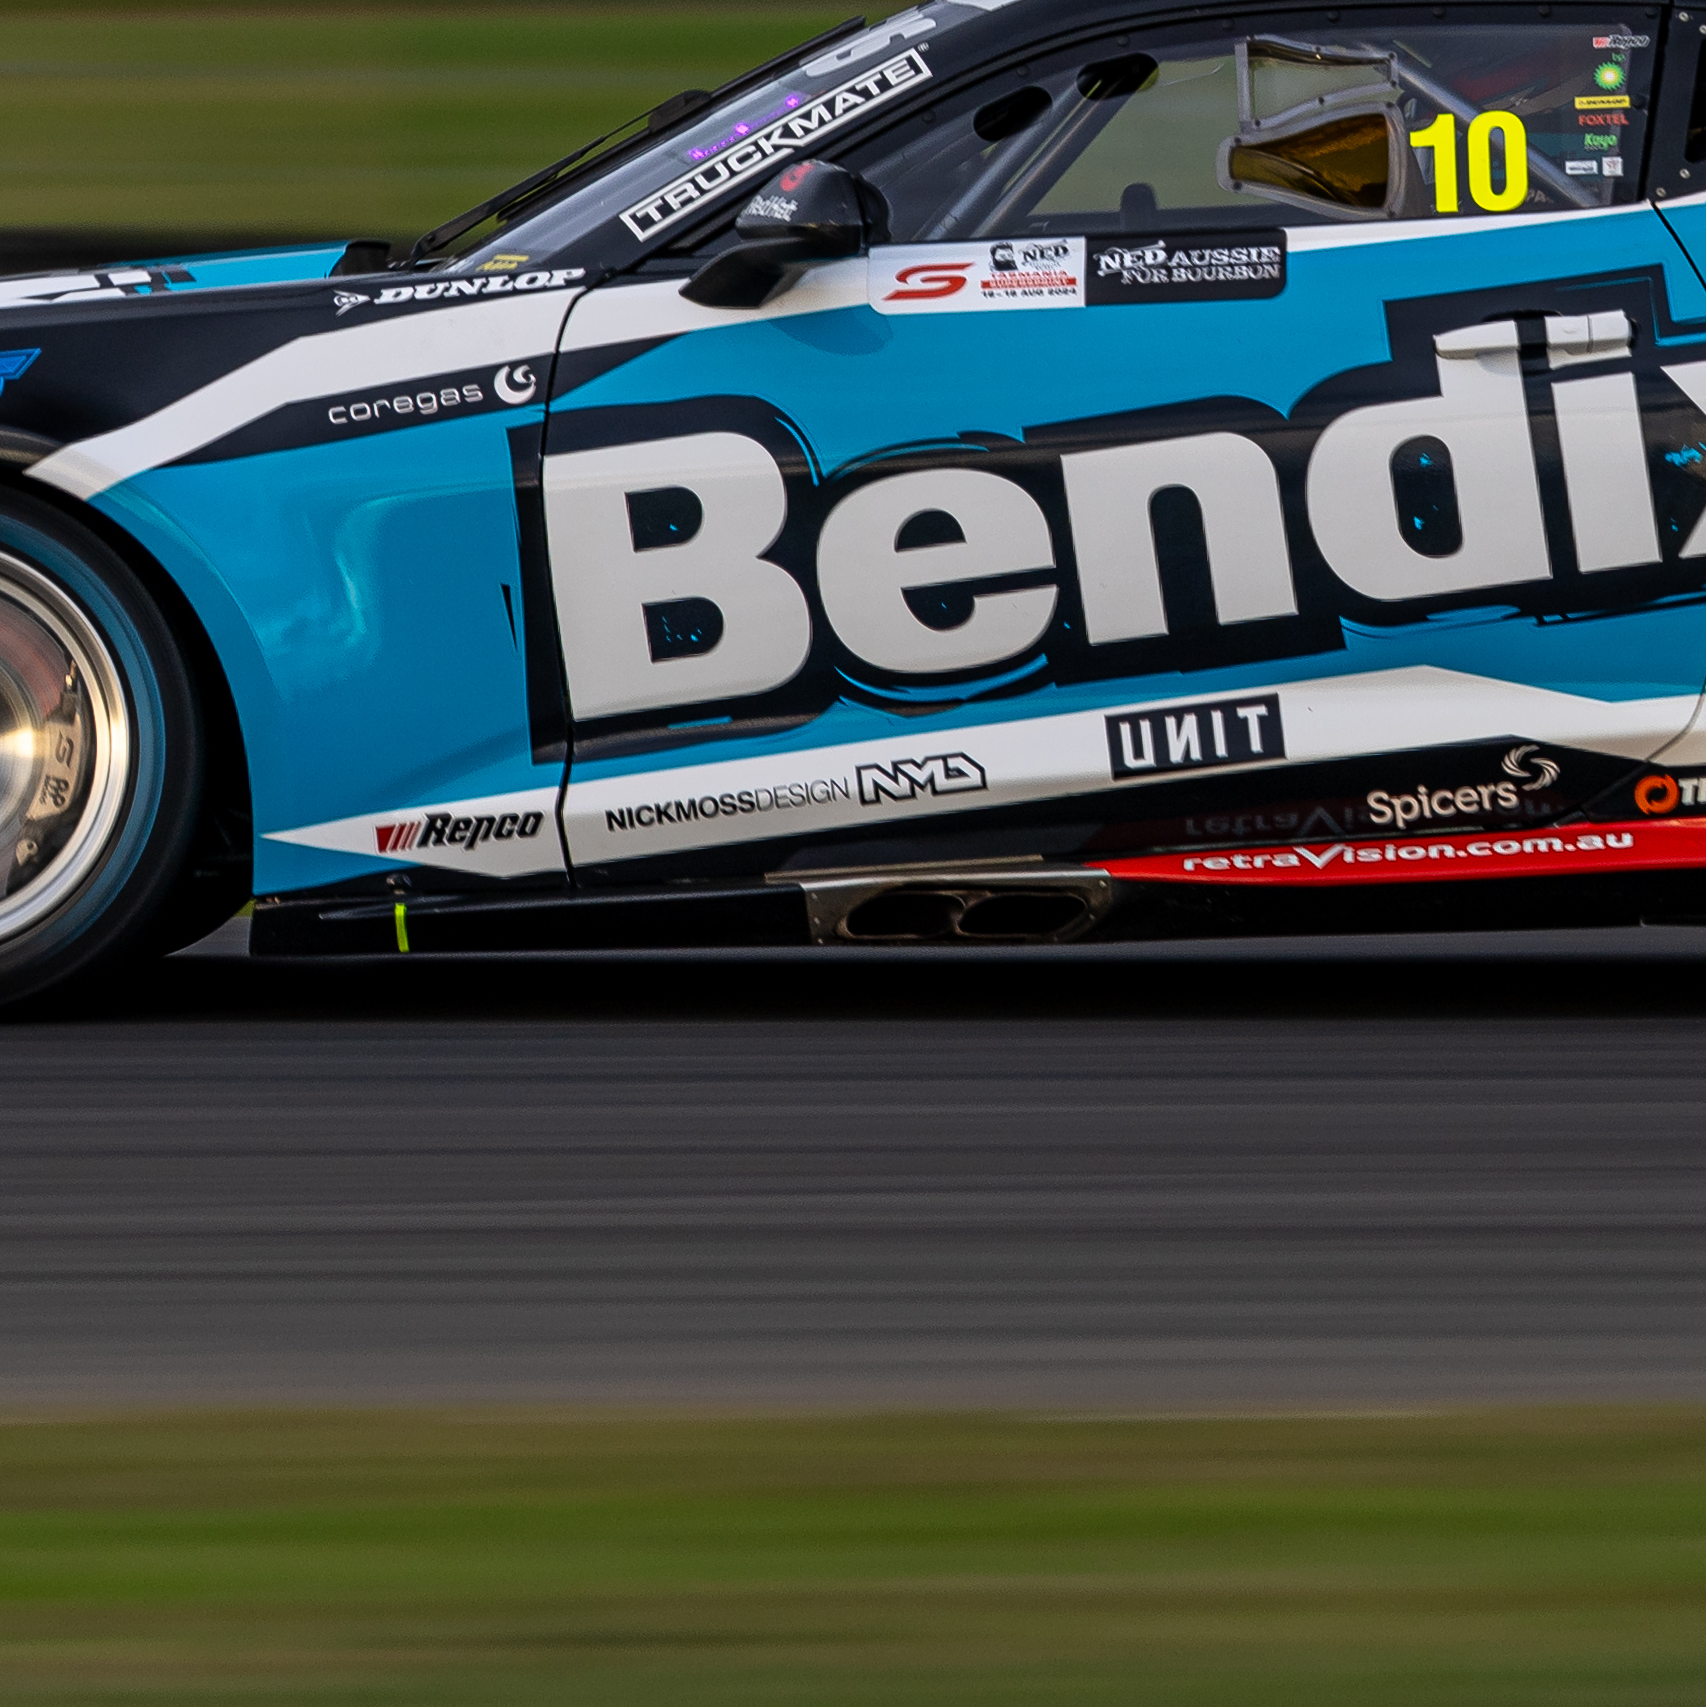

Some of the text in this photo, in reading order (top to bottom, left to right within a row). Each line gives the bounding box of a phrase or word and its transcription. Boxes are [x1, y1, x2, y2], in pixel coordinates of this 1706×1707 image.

[636, 57, 918, 224] TRUCKMATE
[1578, 113, 1630, 126] FOXTEL
[1409, 110, 1529, 213] 10
[1096, 242, 1281, 275] NED AUSSIE
[1121, 264, 1280, 285] FOR BOURBON
[374, 268, 586, 305] DUNLOP
[328, 384, 484, 425] coregas
[1119, 704, 1269, 770] UNIT
[606, 776, 853, 831] NICKMOSSDESIGN
[1367, 780, 1519, 831] Spicers
[417, 810, 546, 851] Repco
[1183, 830, 1634, 874] retraVision.com.au
